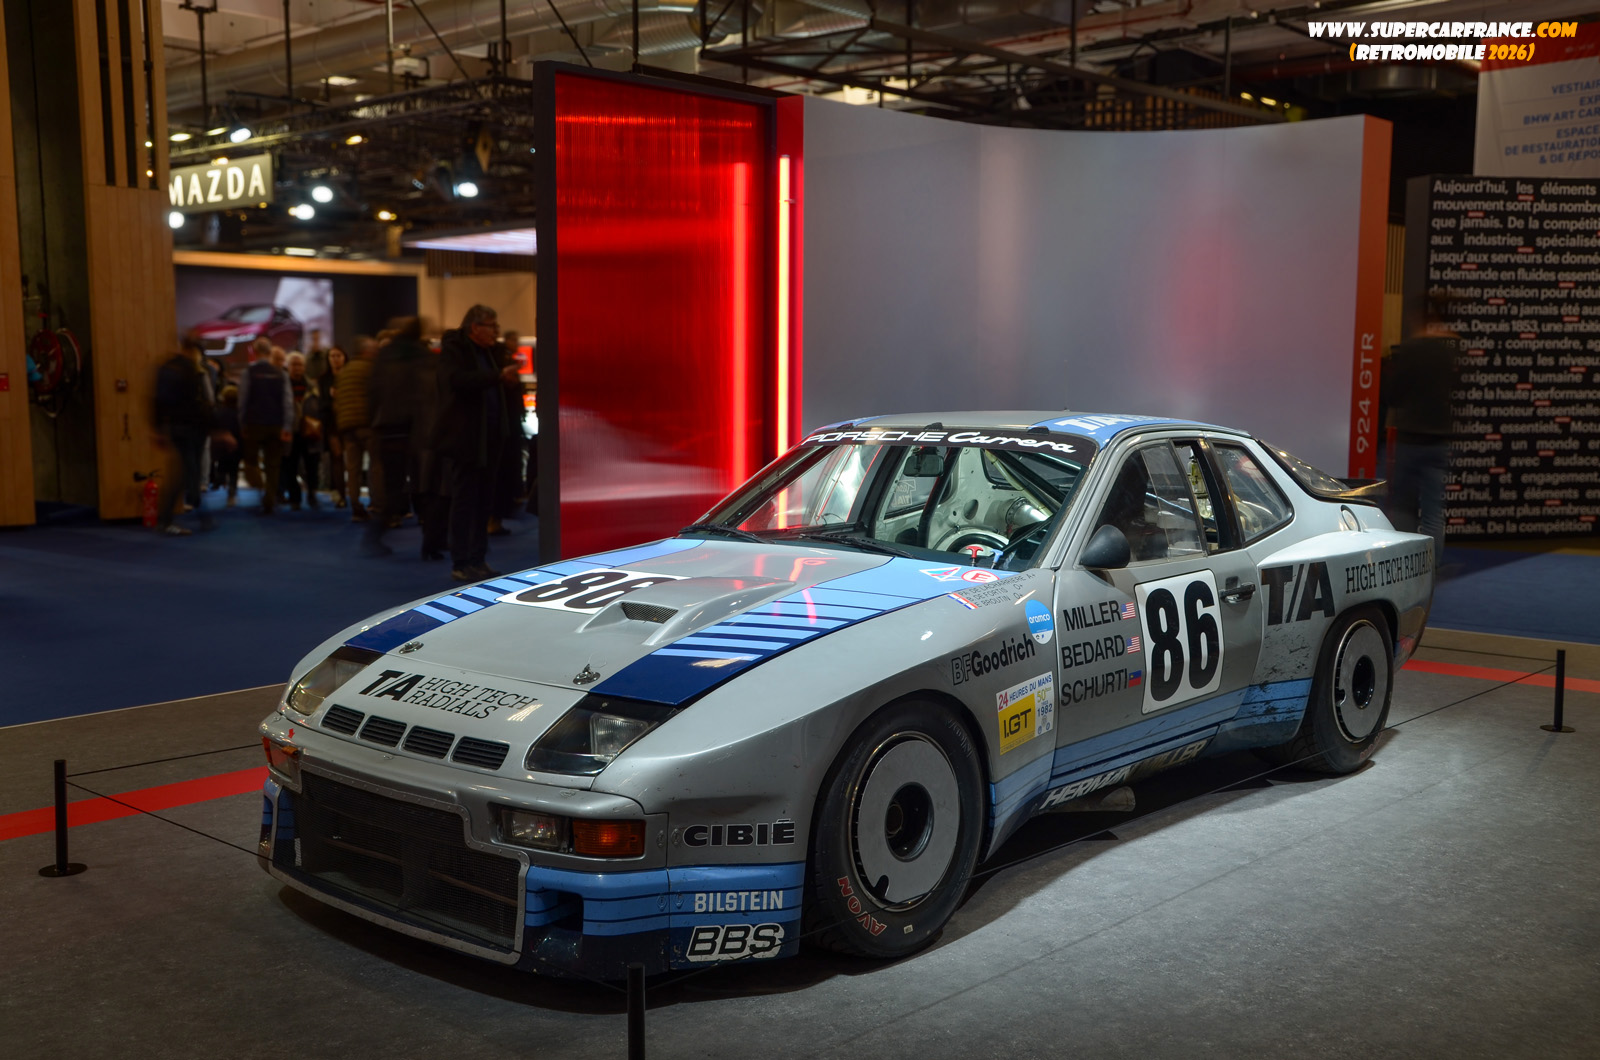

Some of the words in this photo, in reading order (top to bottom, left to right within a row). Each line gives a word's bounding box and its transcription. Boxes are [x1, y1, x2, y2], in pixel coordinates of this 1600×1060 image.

[1523, 114, 1551, 125] BMW
[1553, 110, 1576, 122] ART
[1556, 125, 1600, 139] ESPACE
[1504, 146, 1519, 156] DE
[1539, 155, 1547, 165] &
[1549, 153, 1565, 164] DE
[169, 164, 267, 207] MAZDA
[1433, 179, 1509, 195] Aujourd'hui,
[1516, 181, 1534, 195] les
[1540, 182, 1597, 196] éléments
[1433, 199, 1505, 211] mouvement
[1506, 200, 1531, 212] sont
[1533, 199, 1558, 214] plus
[1431, 217, 1456, 231] que
[1459, 215, 1504, 231] jamais.
[1507, 216, 1525, 229] De
[1528, 215, 1539, 229] la
[1430, 235, 1453, 246] aux
[1463, 232, 1524, 246] industries
[1535, 233, 1600, 249] spécialisé
[1429, 249, 1489, 266] jusqu'aux
[1490, 252, 1542, 264] serveurs
[1544, 250, 1560, 264] de
[1561, 251, 1600, 264] donné
[1429, 266, 1440, 280] la
[1441, 266, 1499, 280] demande
[1500, 269, 1516, 280] en
[1517, 267, 1556, 281] fluides
[1557, 269, 1600, 282] essenti
[1447, 284, 1482, 297] haute
[1483, 285, 1539, 300] précision
[1540, 288, 1570, 301] pour
[1447, 301, 1498, 315] frictions
[1499, 302, 1519, 315] n'a
[1519, 302, 1559, 317] jamais
[1560, 302, 1580, 316] été
[1471, 319, 1510, 334] Depuis
[1511, 319, 1540, 334] 1853,
[1541, 322, 1563, 333] une
[1459, 336, 1495, 352] guide
[1505, 336, 1583, 352] comprendre,
[1359, 333, 1375, 390] GTR
[1493, 353, 1502, 366] à
[1505, 354, 1533, 367] tous
[1537, 353, 1555, 367] les
[1558, 353, 1600, 367] niveau
[1528, 369, 1583, 384] humaine
[1466, 386, 1483, 400] de
[1484, 386, 1495, 400] la
[1495, 386, 1530, 400] haute
[1489, 405, 1535, 417] moteur
[1356, 397, 1371, 454] 924
[1499, 420, 1563, 435] essentiels,
[801, 431, 948, 446] PORSCHE
[947, 431, 1077, 454] Carrera
[1511, 440, 1528, 451] un
[1536, 436, 1580, 451] monde
[1509, 456, 1540, 468] avec
[1499, 472, 1512, 484] et
[1499, 487, 1517, 500] les
[1523, 486, 1579, 500] éléments
[1488, 505, 1515, 518] sont
[1515, 503, 1541, 519] plus
[1487, 520, 1505, 533] De
[1505, 519, 1518, 532] la
[1518, 519, 1593, 535] compétition
[1345, 562, 1378, 594] HIGH
[1378, 556, 1404, 587] TECH
[1260, 560, 1336, 626] T/A
[1028, 613, 1051, 625] aramco
[1063, 600, 1121, 632] MILLER
[1145, 580, 1220, 702] 86
[951, 632, 1036, 686] BFGoodrich
[1061, 634, 1125, 670] BEDARD
[359, 669, 426, 701] T/A
[417, 677, 480, 698] HIGH
[473, 687, 538, 710] TECH
[998, 691, 1009, 711] 24
[1009, 685, 1029, 702] HEURES
[1029, 681, 1037, 692] DU
[1037, 674, 1053, 688] MANS
[1060, 667, 1128, 707] SCHURTI
[403, 690, 499, 720] RADIALS
[1037, 703, 1053, 718] 1982
[1003, 708, 1031, 738] I.GT
[683, 818, 796, 847] CIBIÉ
[694, 890, 784, 913] BILSTEIN
[836, 875, 888, 937] AVON
[687, 923, 784, 961] BBS
